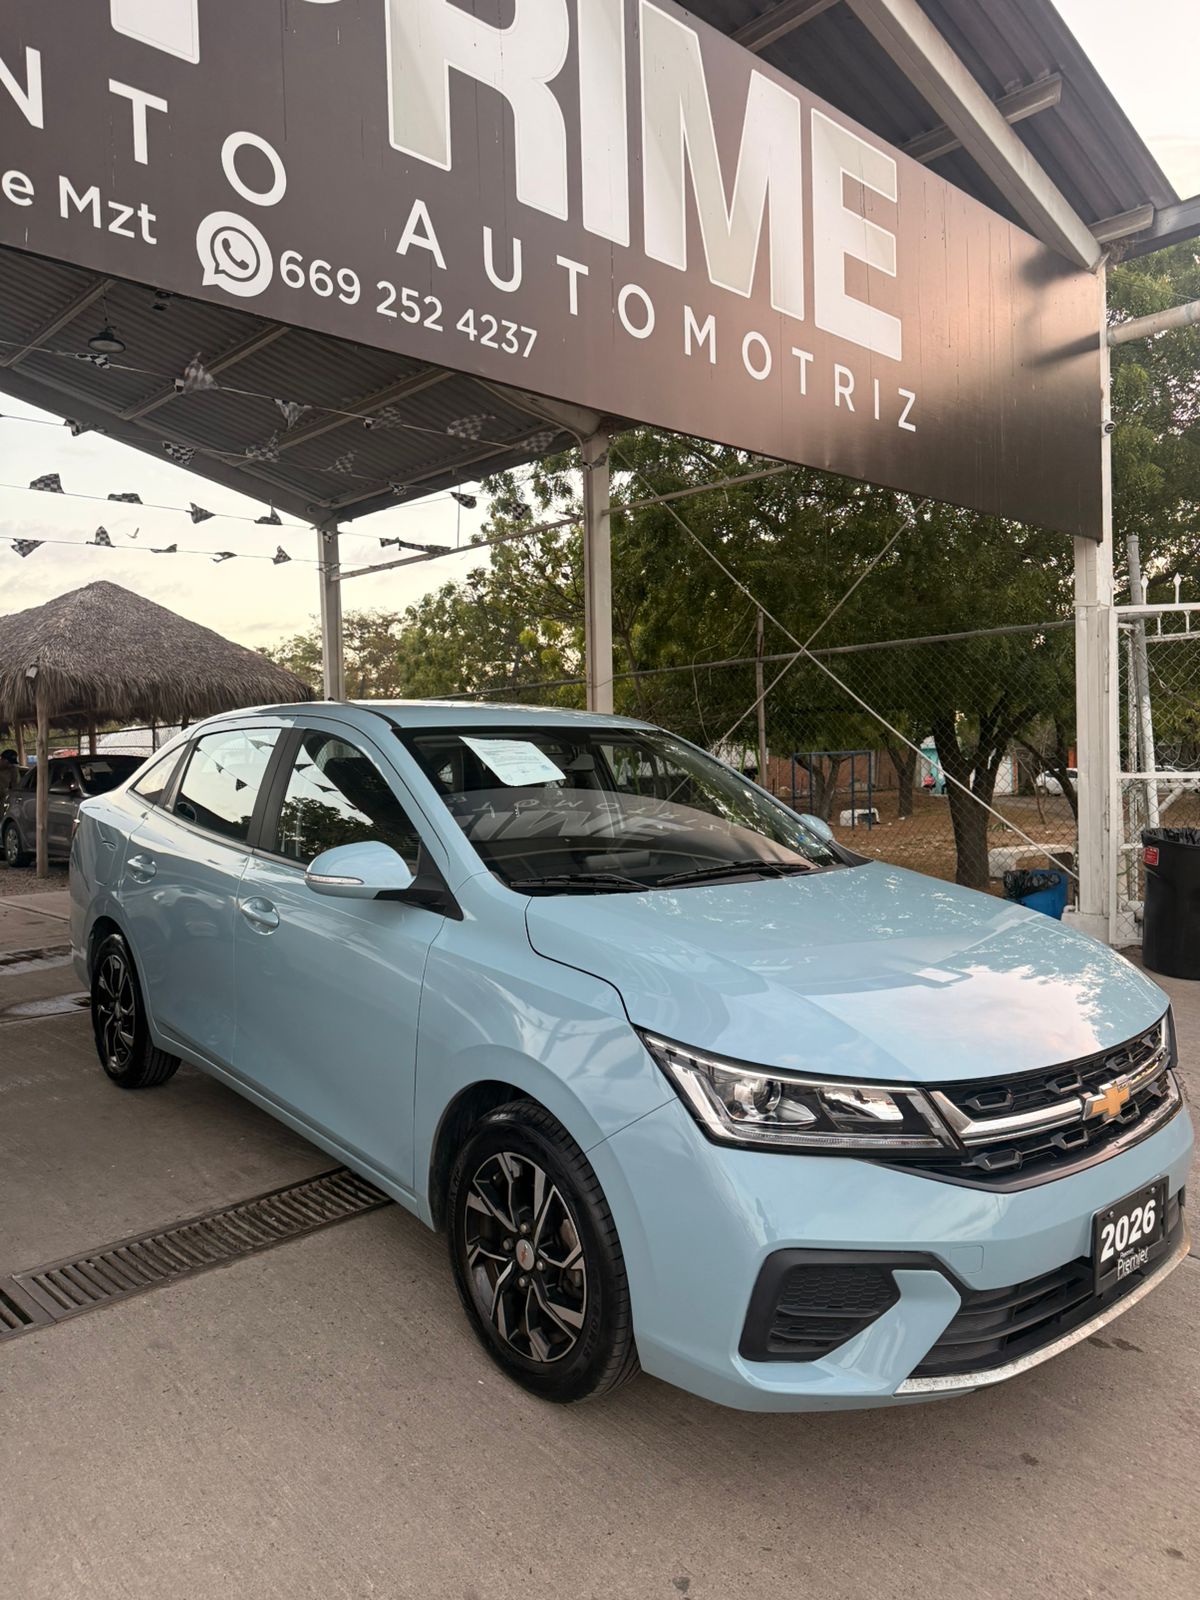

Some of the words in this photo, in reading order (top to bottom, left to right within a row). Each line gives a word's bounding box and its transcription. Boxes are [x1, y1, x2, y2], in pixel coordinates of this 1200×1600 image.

[59, 175, 157, 245] Mzt
[280, 250, 361, 304] 669
[376, 281, 443, 332] 252
[457, 309, 537, 358] 4237
[396, 199, 917, 432] AUTOMOTRIZ
[1101, 1200, 1156, 1263] 2026
